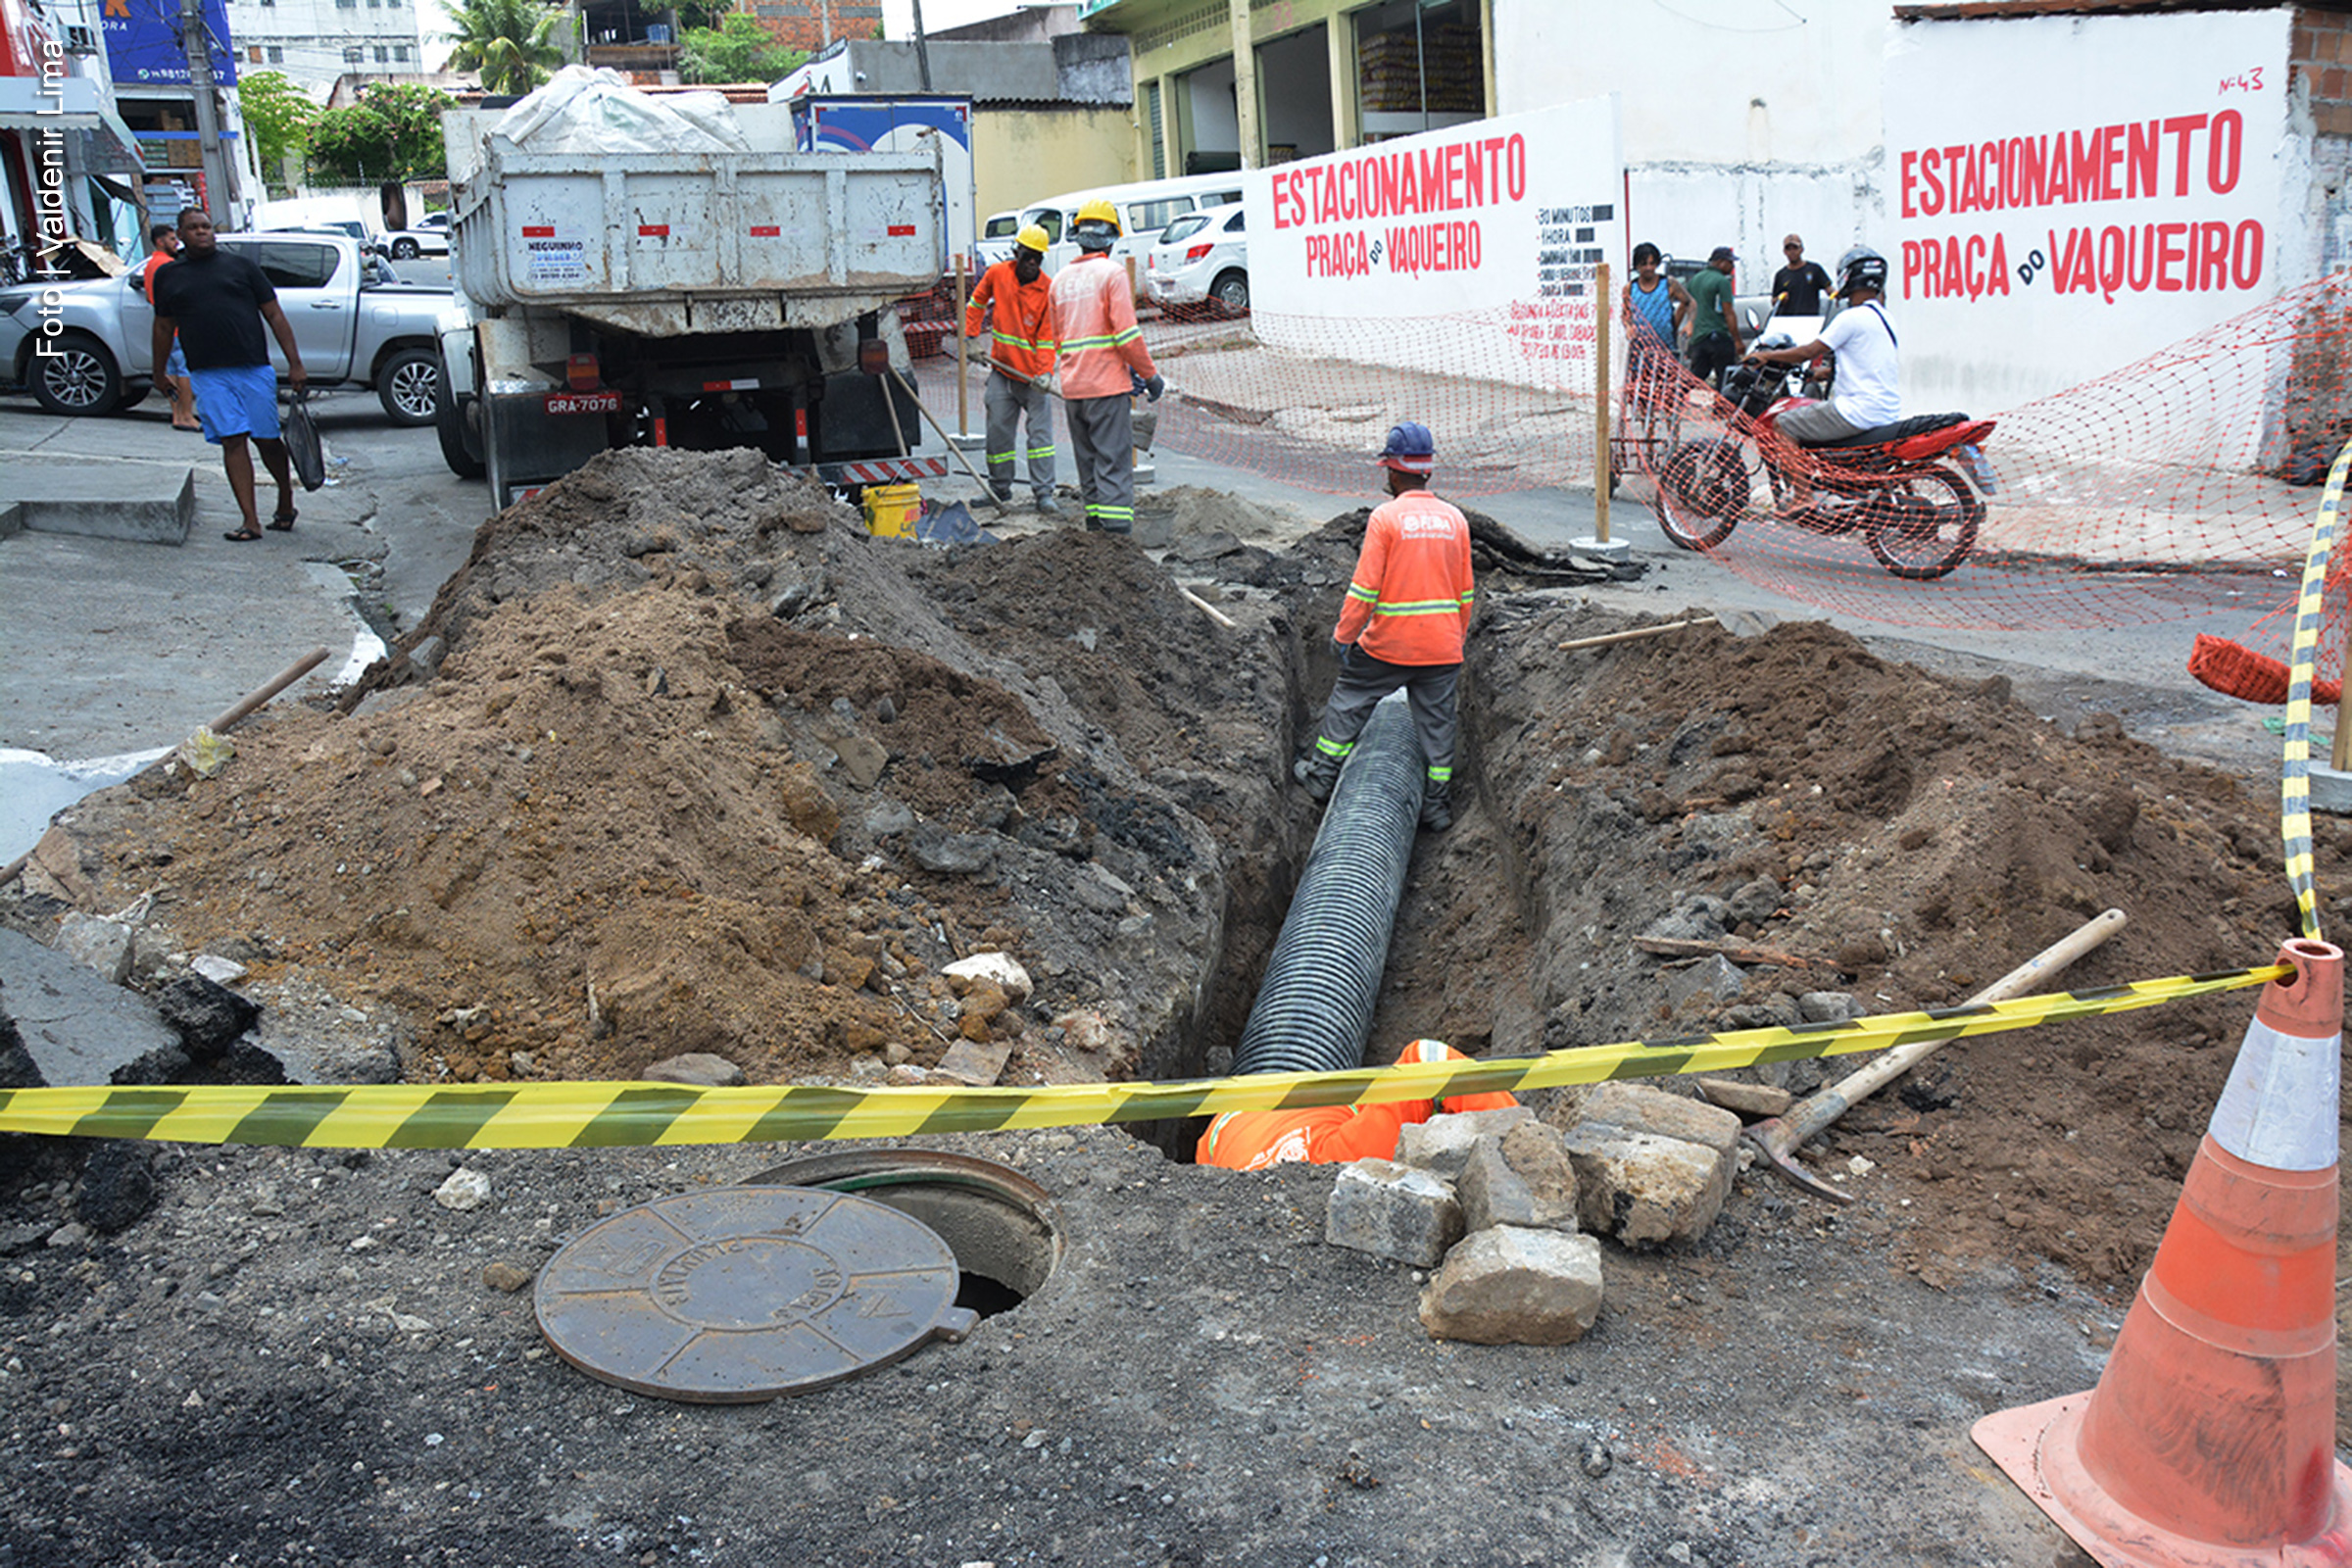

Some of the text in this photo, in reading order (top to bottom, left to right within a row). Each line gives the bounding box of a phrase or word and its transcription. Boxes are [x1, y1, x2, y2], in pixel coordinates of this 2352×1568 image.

[1272, 132, 1526, 229] ESTACIONAMENTO
[1901, 109, 2242, 219] ESTACIONAMENTO
[1305, 220, 1481, 280] PRAÇA DO VAQUEIRO
[1551, 206, 1592, 224] MINUTOS
[1902, 219, 2264, 305] PRAÇA DO VAQUEIRO
